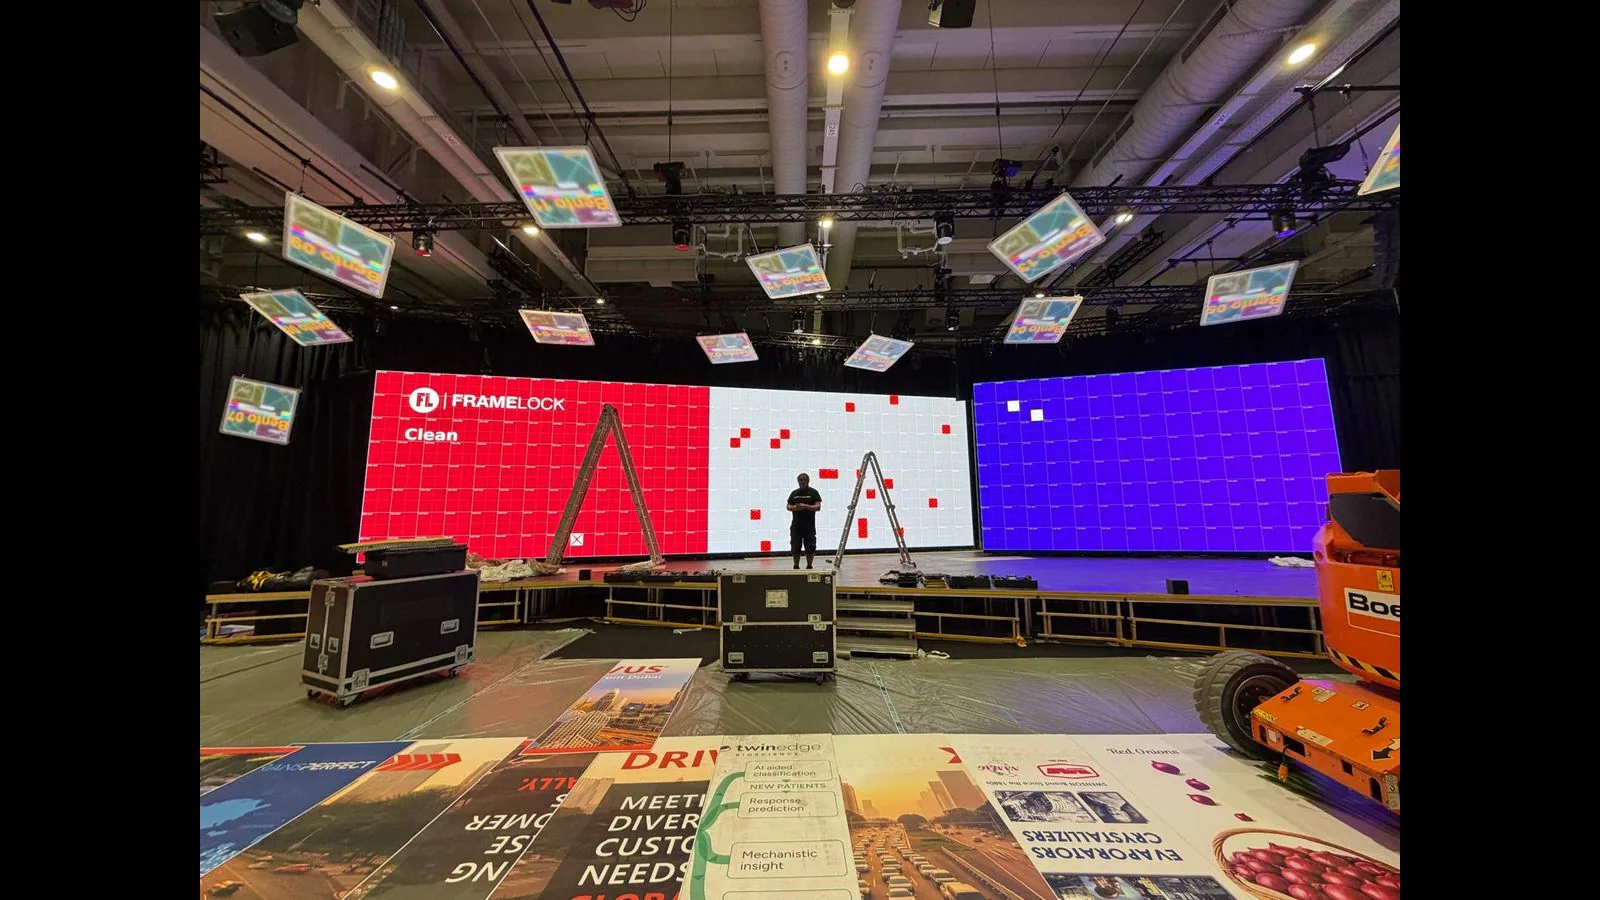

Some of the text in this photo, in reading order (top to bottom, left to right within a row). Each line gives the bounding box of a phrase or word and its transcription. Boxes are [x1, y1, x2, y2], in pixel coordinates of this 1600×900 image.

[531, 194, 609, 213] Bento 11
[1039, 224, 1093, 260] Bento
[320, 250, 383, 285] Bento
[783, 272, 824, 286] Bento
[1231, 294, 1285, 310] Bento
[1028, 323, 1064, 333] Bento
[452, 393, 565, 411] FRAMELOCK
[246, 413, 291, 432] Bento
[404, 427, 458, 441] Clean
[736, 742, 821, 753] twinedge
[748, 804, 805, 814] prediction
[749, 797, 802, 806] Response
[607, 813, 700, 832] DIVER
[484, 835, 535, 854] SE
[1022, 830, 1162, 845] CRYSTALLIZERS
[742, 849, 818, 859] Mechanistic
[1031, 846, 1184, 862] EVAPORATORS
[444, 861, 509, 883] NG
[740, 861, 784, 872] insight
